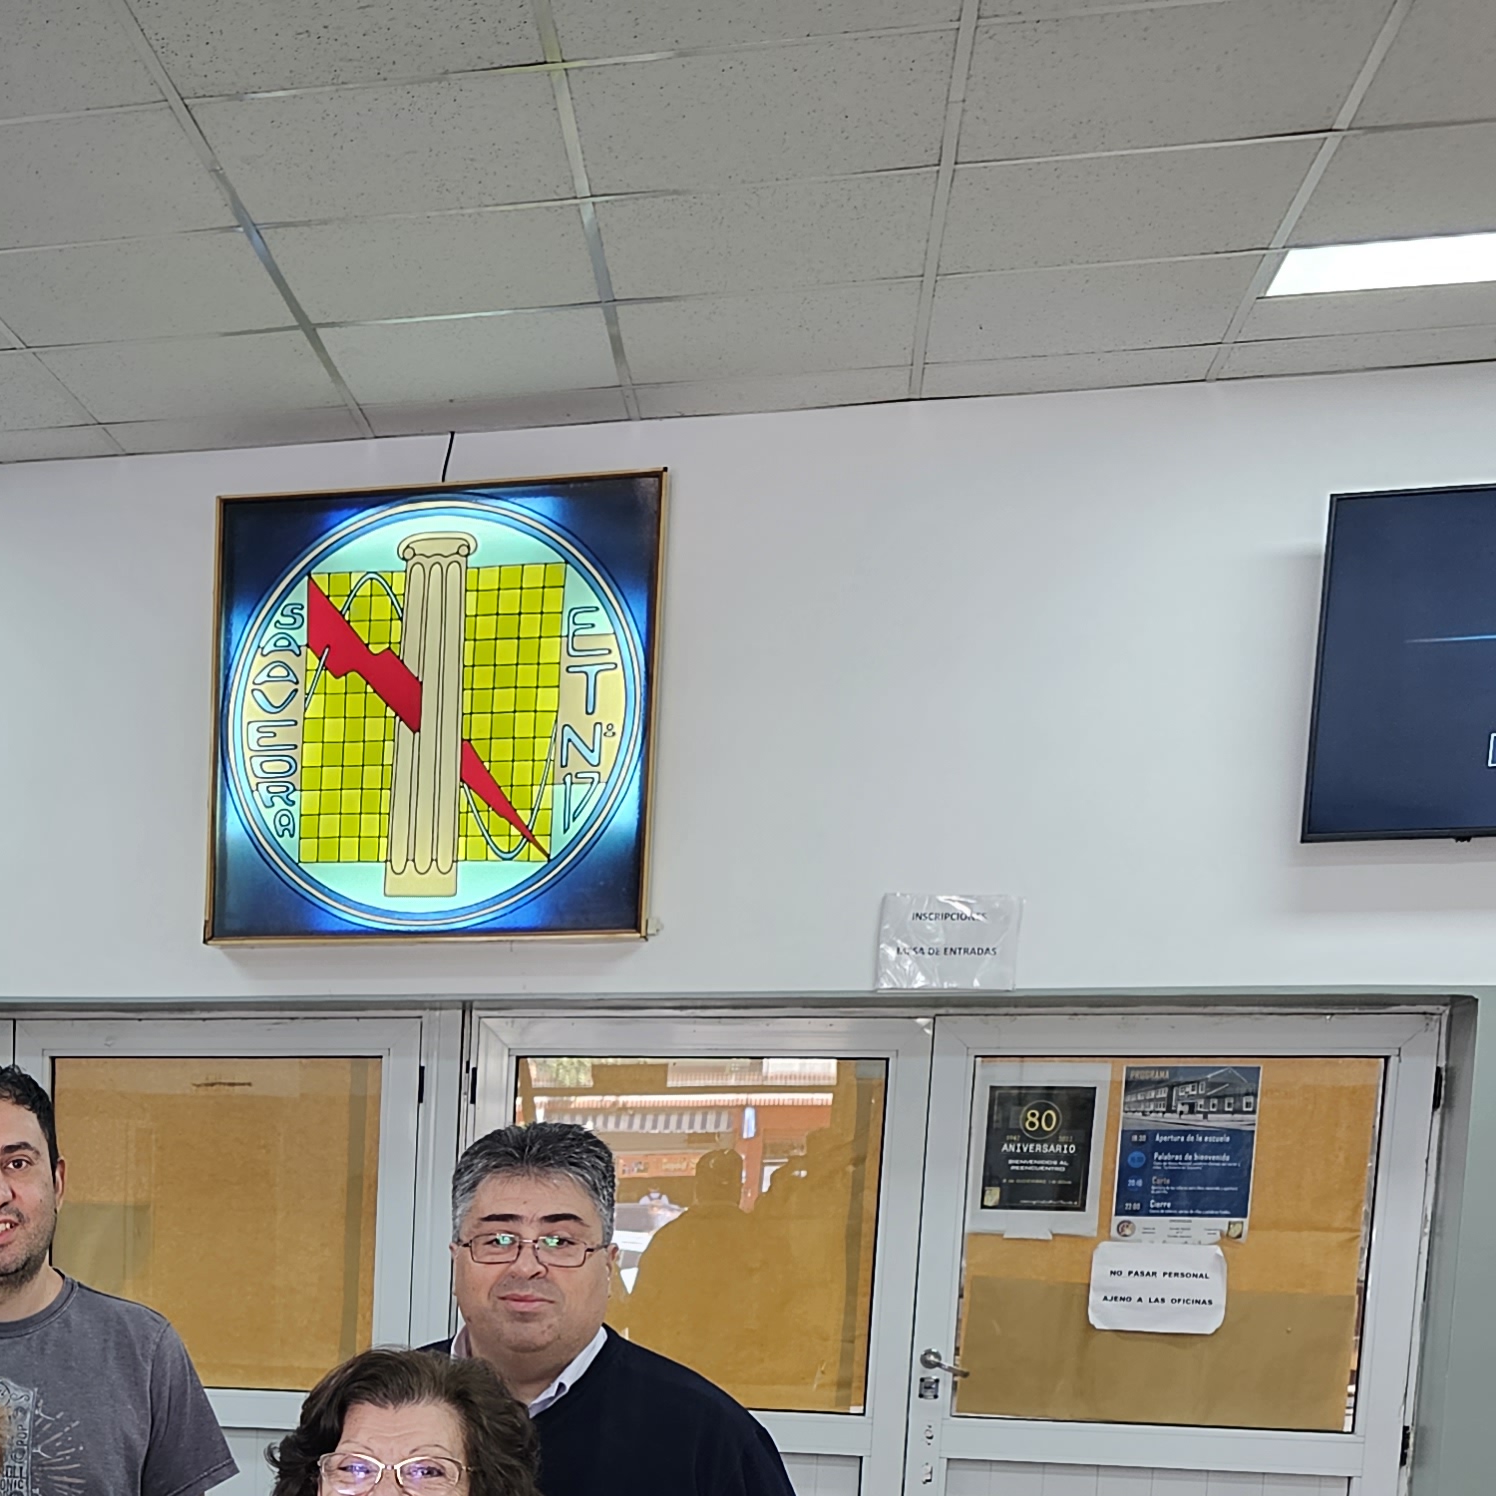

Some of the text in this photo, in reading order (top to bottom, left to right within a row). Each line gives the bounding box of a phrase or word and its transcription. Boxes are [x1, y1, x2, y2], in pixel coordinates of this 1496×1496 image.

[246, 602, 306, 838] SAAVEDRA
[927, 946, 941, 956] DE
[943, 947, 998, 956] ENTRADAS
[1025, 1109, 1057, 1131] 80
[1155, 1132, 1185, 1143] Apertura
[1186, 1133, 1195, 1142] de
[1204, 1134, 1231, 1143] escuela
[1001, 1143, 1076, 1153] ANIVERSARIO
[1153, 1151, 1183, 1161] Palabras
[1184, 1152, 1192, 1161] de
[1193, 1152, 1231, 1161] bienvenida
[1127, 1270, 1158, 1278] PASAR
[1162, 1271, 1210, 1280] PERSONAL
[1102, 1295, 1132, 1303] AJENO
